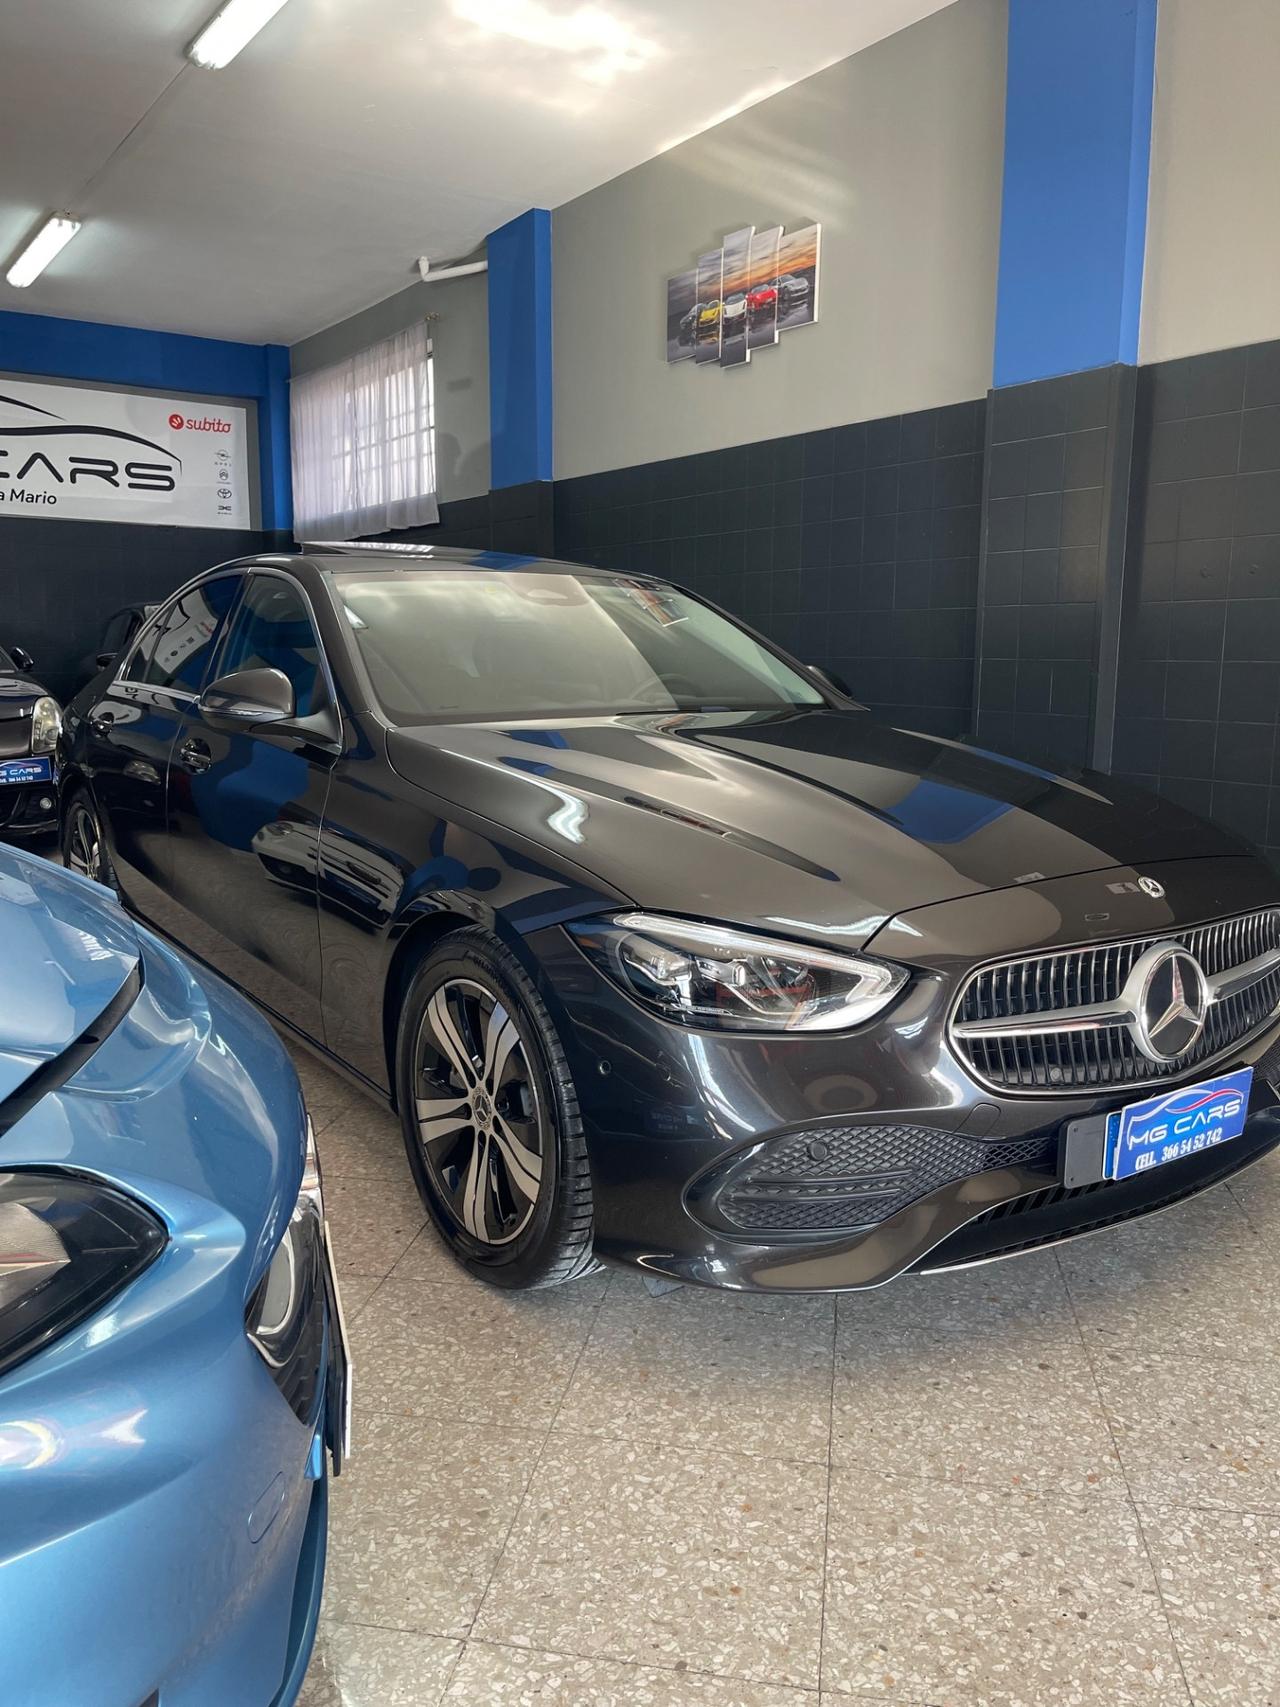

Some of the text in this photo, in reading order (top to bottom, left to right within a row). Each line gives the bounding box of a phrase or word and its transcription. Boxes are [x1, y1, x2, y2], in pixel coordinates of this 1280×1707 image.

[186, 417, 232, 433] subito
[0, 450, 175, 491] ARS
[10, 488, 57, 505] Mario
[1128, 1099, 1240, 1150] MG CARS
[1135, 1127, 1222, 1170] CELL. 366 54 52 742
